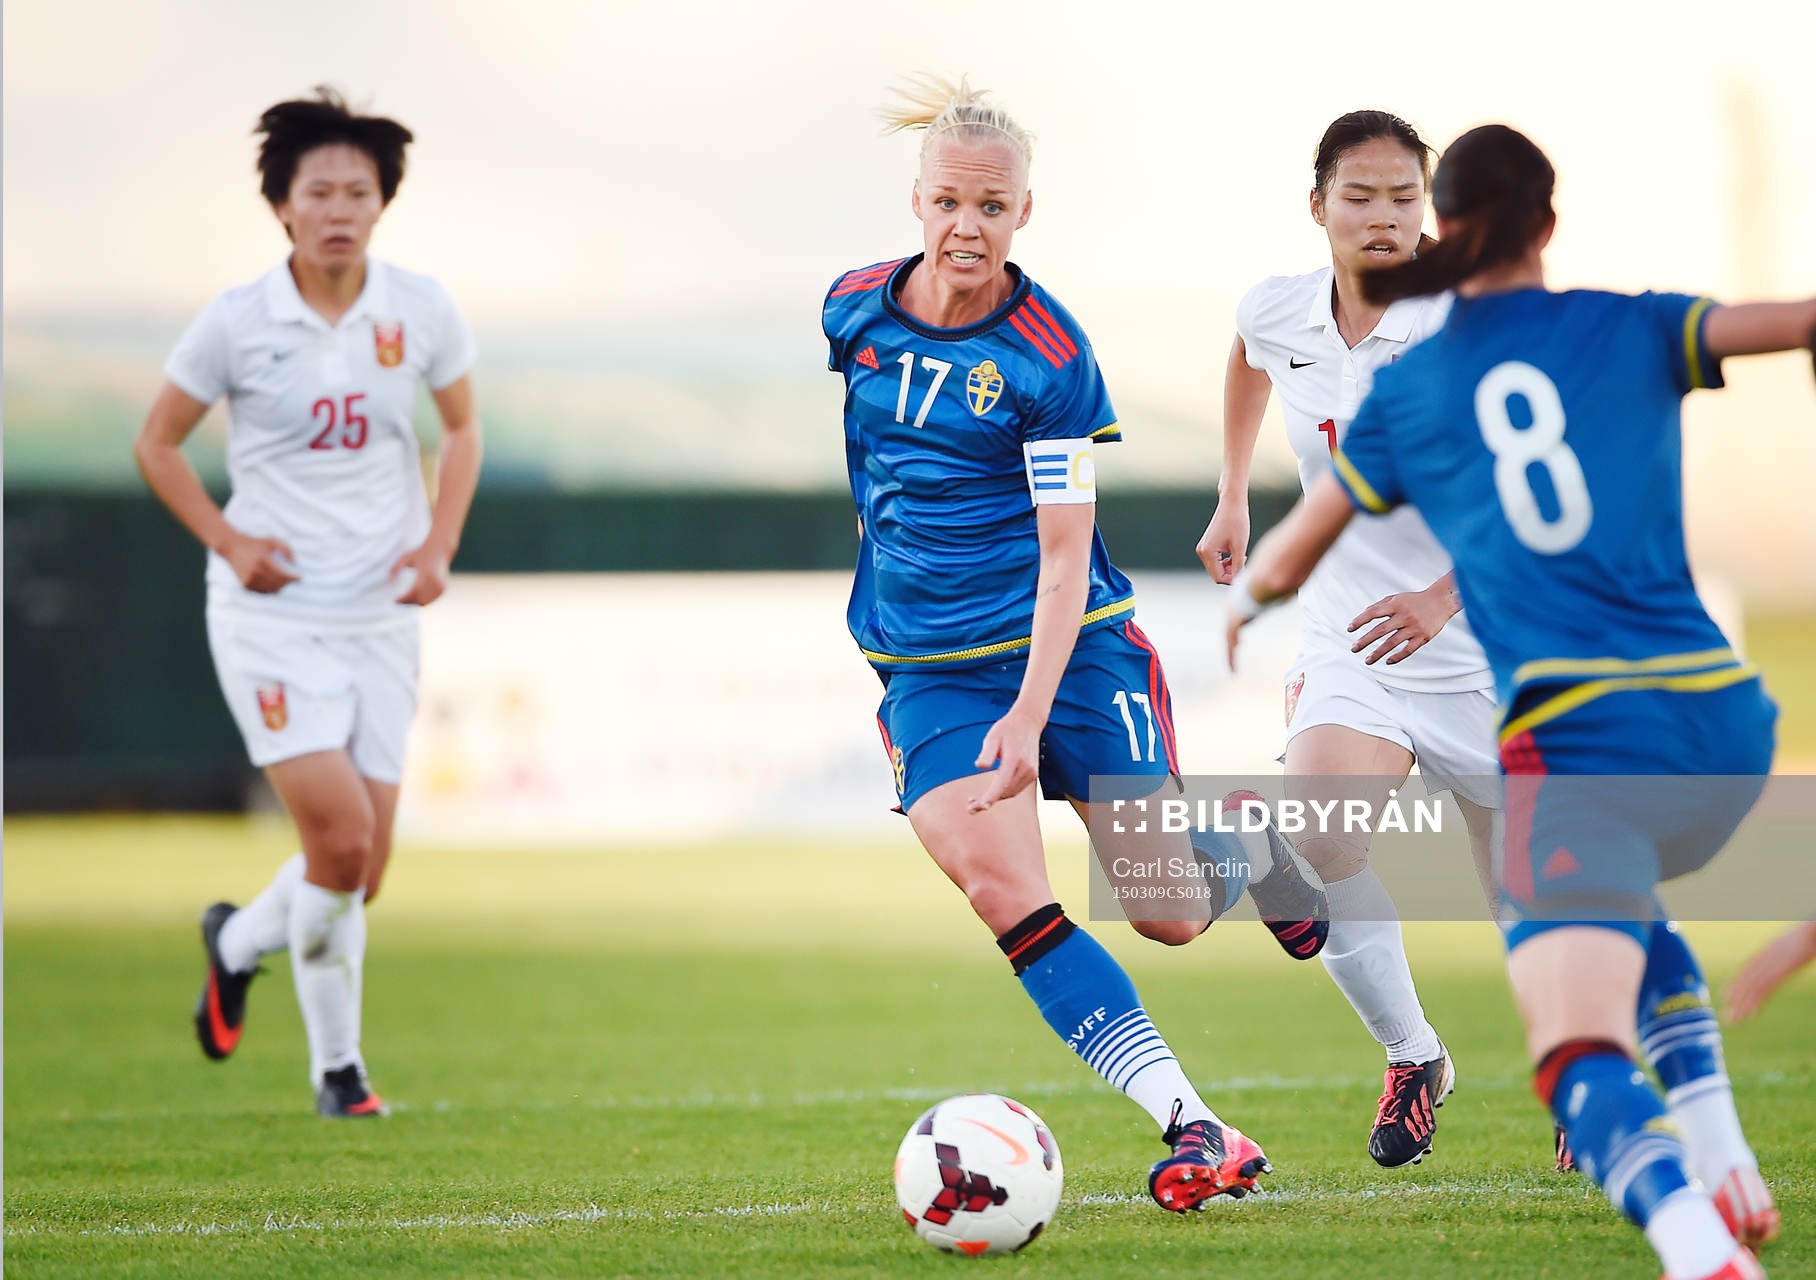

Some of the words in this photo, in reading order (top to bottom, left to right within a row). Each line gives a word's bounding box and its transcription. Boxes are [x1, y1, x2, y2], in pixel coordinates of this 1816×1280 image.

[308, 393, 370, 450] 25
[895, 352, 952, 428] 17
[1072, 451, 1095, 490] C
[1474, 361, 1593, 555] 8
[1111, 690, 1156, 763] 17
